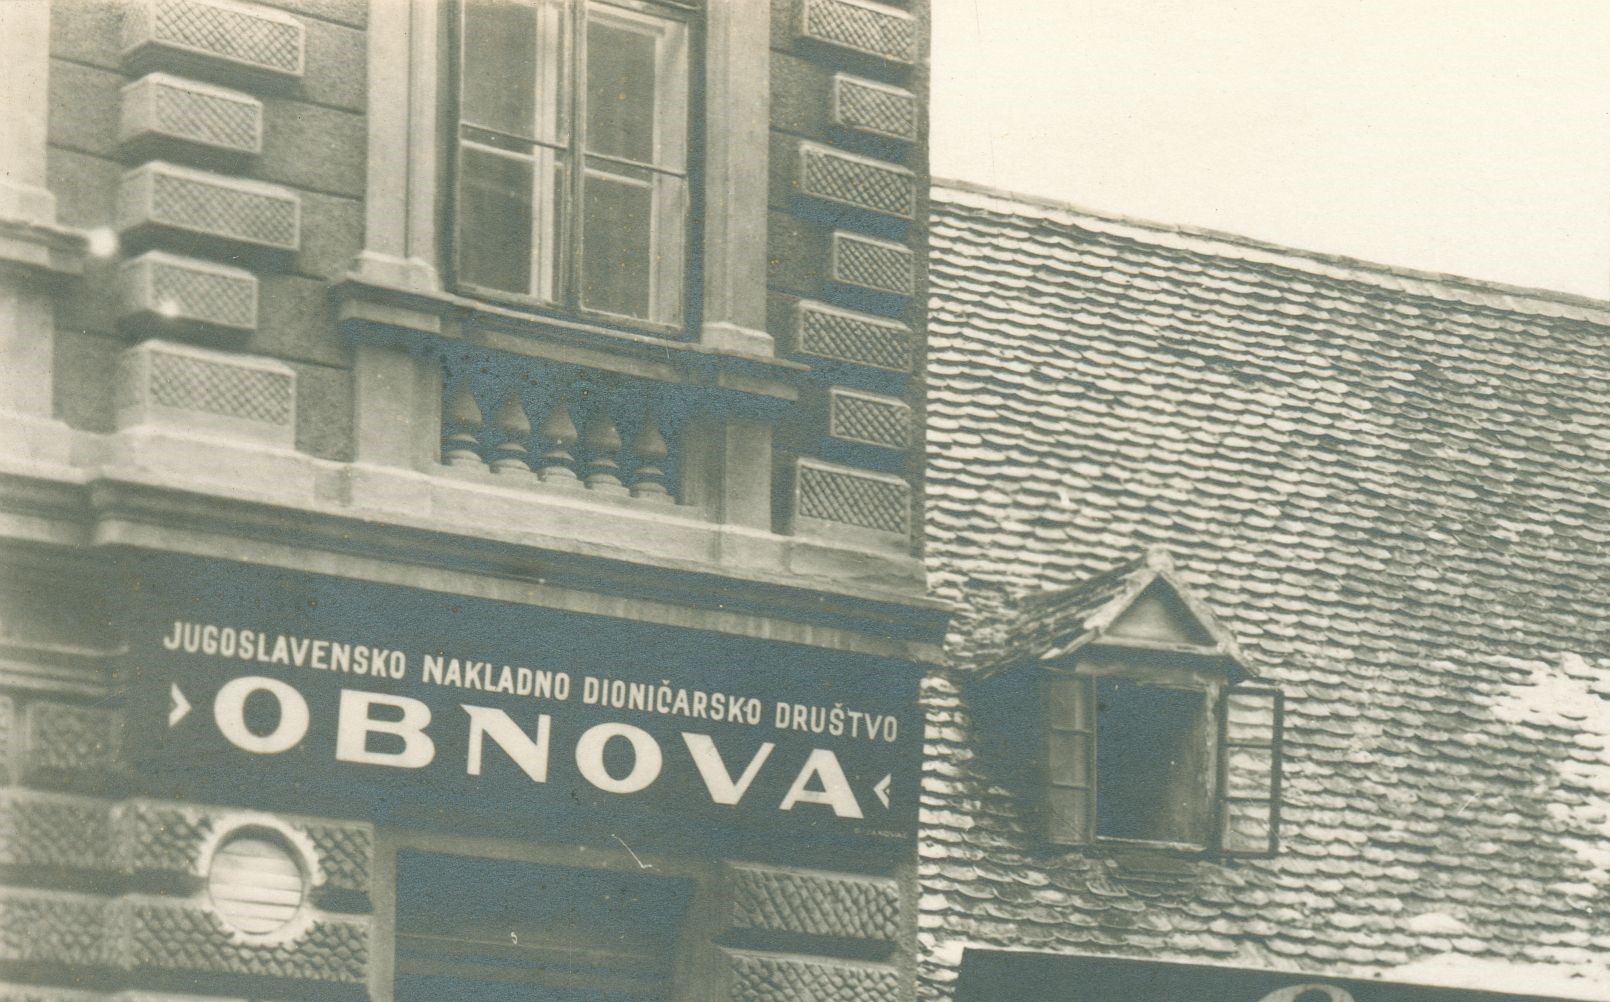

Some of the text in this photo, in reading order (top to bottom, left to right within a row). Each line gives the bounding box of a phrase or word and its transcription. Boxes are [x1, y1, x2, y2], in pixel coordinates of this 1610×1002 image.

[163, 621, 899, 743] JUGOSLAVENSKO NAKLADNO DIONIČARSKO DRUŠTVO
